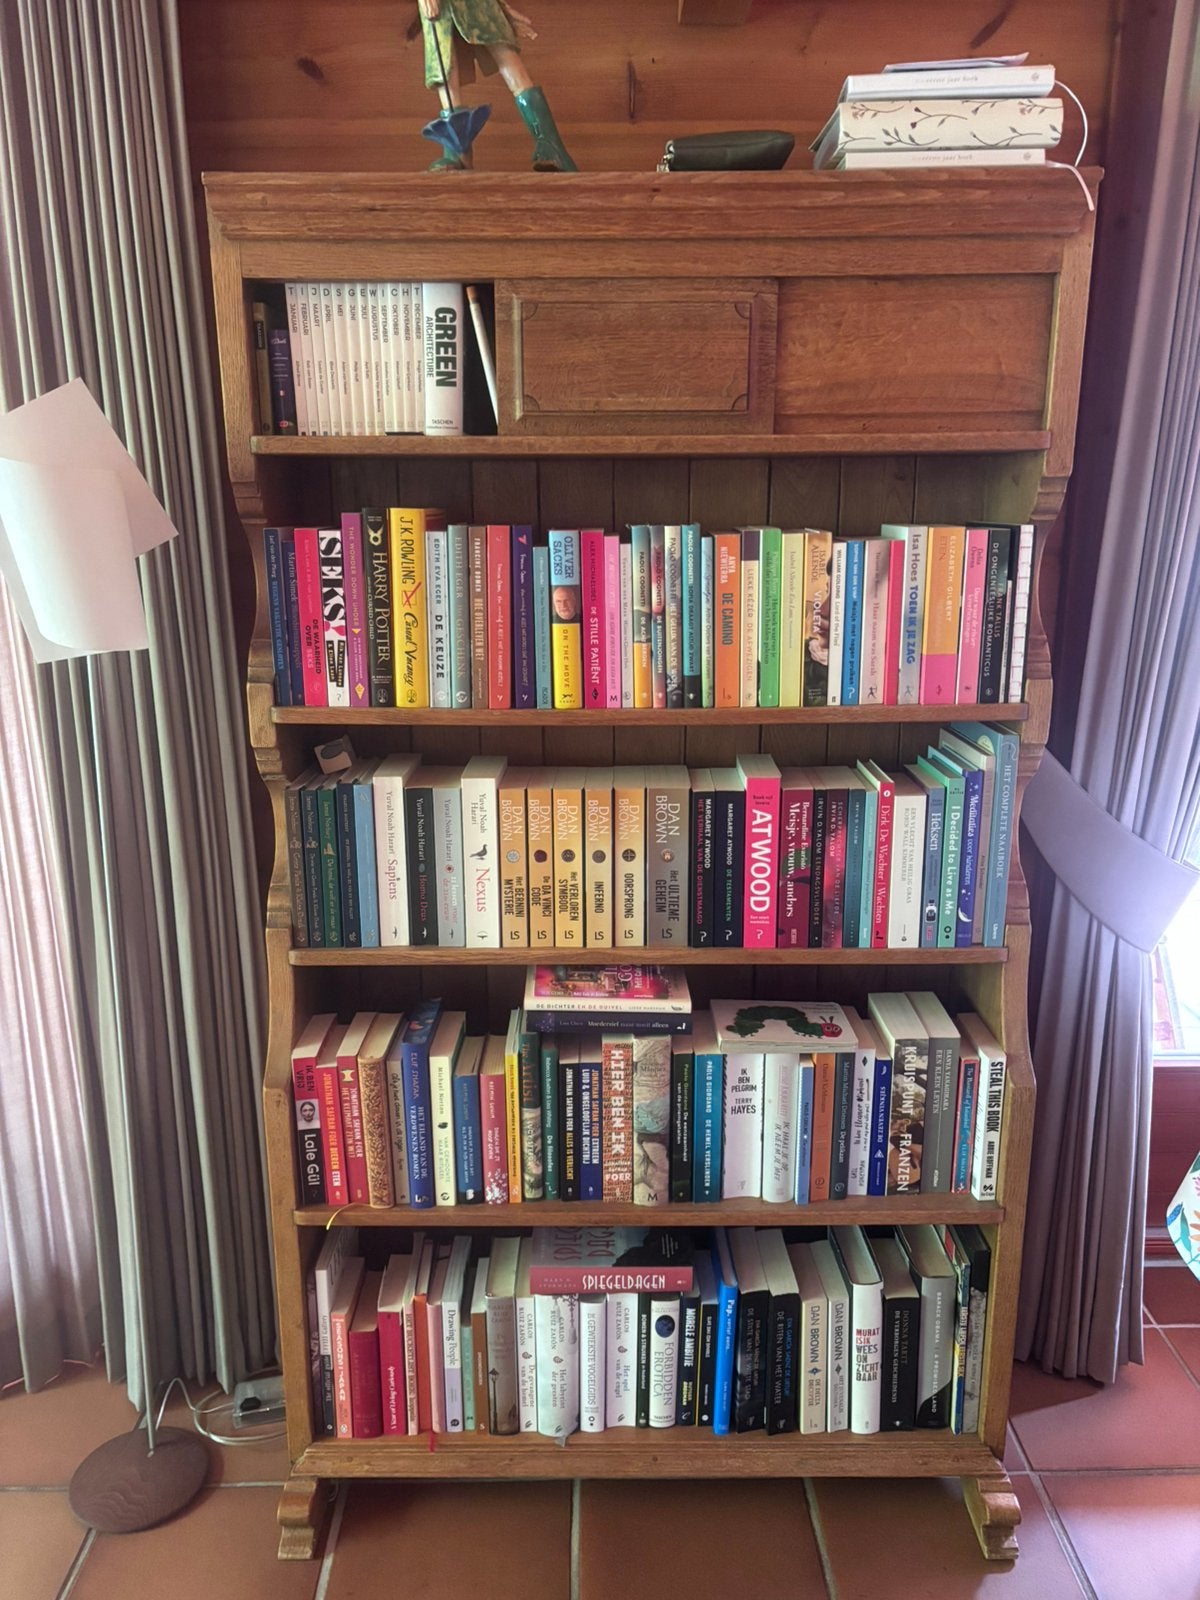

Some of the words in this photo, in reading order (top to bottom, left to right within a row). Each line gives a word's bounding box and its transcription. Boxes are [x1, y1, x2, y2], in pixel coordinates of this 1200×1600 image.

[435, 307, 457, 387] GREEN
[400, 517, 413, 536] J.K.
[912, 534, 922, 549] Isa
[553, 541, 562, 575] SACKS
[564, 536, 573, 578] OLIVER
[811, 545, 820, 582] ALLENDE
[992, 543, 999, 553] DE
[372, 552, 389, 603] HARRY
[720, 547, 728, 583] NIEWIERRA
[910, 553, 920, 582] Hoes
[722, 593, 733, 605] DE
[909, 585, 918, 614] TOEN
[988, 556, 998, 622] ONGENEESLIJKE
[435, 615, 443, 631] DE
[722, 608, 733, 645] CAMINO
[812, 590, 822, 632] VIOLETA
[908, 617, 917, 627] IK
[375, 608, 390, 663] POTTER
[563, 629, 568, 641] ON
[590, 618, 598, 644] STILLE
[907, 630, 916, 639] JE
[436, 638, 444, 678] KEUZE
[591, 648, 600, 684] PATIËNT
[907, 641, 915, 664] ZAG
[984, 624, 993, 677] ROMANTICUS
[1003, 765, 1011, 782] HET
[501, 800, 512, 840] BROWN
[512, 806, 522, 834] DAN
[529, 800, 540, 840] BROWN
[540, 806, 550, 833] DAN
[557, 800, 567, 840] BROWN
[568, 806, 578, 834] DAN
[588, 800, 598, 840] BROWN
[599, 806, 609, 834] DAN
[619, 799, 629, 839] BROWN
[630, 805, 639, 833] DAN
[655, 796, 667, 843] BROWN
[668, 803, 680, 836] DAN
[786, 802, 800, 839] Meisje,
[801, 802, 809, 840] Bernardine
[880, 805, 890, 826] Dirk
[999, 785, 1010, 831] COMPLETE
[880, 829, 889, 842] De
[930, 813, 942, 851] Heksen
[950, 812, 960, 850] Decided
[750, 809, 772, 912] ATWOOD
[786, 843, 796, 878] vrouw,
[800, 843, 808, 870] Evaristo
[878, 845, 887, 879] Wachter
[949, 854, 957, 863] to
[996, 834, 1008, 878] NAAIBOEK
[386, 859, 400, 900] Sapiens
[476, 869, 490, 912] Nexus
[543, 885, 551, 897] DA
[670, 870, 679, 882] Het
[946, 866, 957, 884] Live
[504, 879, 514, 915] MYSTERIE
[515, 888, 524, 917] BERNINI
[532, 887, 540, 906] CODE
[543, 898, 551, 917] VINCI
[559, 879, 568, 914] SYMBOOL
[570, 884, 579, 921] VERLOREN
[594, 882, 604, 913] INFERNO
[624, 873, 633, 919] OORSPRONG
[656, 880, 667, 913] GEHEIM
[668, 884, 679, 922] ULTIEME
[876, 888, 887, 924] Wachten
[945, 888, 955, 896] as
[945, 900, 955, 915] Me
[611, 1050, 624, 1091] HIER
[902, 1046, 916, 1115] KRUISPUNT
[990, 1062, 1003, 1087] STEAL
[611, 1096, 624, 1128] BEN
[731, 1106, 756, 1114] HAYES
[988, 1089, 1001, 1109] THIS
[986, 1110, 1000, 1132] BOOK
[304, 1134, 317, 1160] Lale
[612, 1132, 625, 1154] IK
[307, 1164, 320, 1185] Gül
[897, 1134, 912, 1191] FRANZEN
[583, 1275, 665, 1290] SPIEGELDAGEN
[447, 1310, 456, 1341] Drawing
[685, 1308, 696, 1337] MORELE
[811, 1306, 820, 1325] DAN
[448, 1343, 457, 1365] People
[684, 1338, 695, 1367] AMBITIE
[810, 1328, 820, 1363] BROWN
[654, 1352, 663, 1397] EROTICA
[664, 1342, 674, 1406] FORBIDDEN
